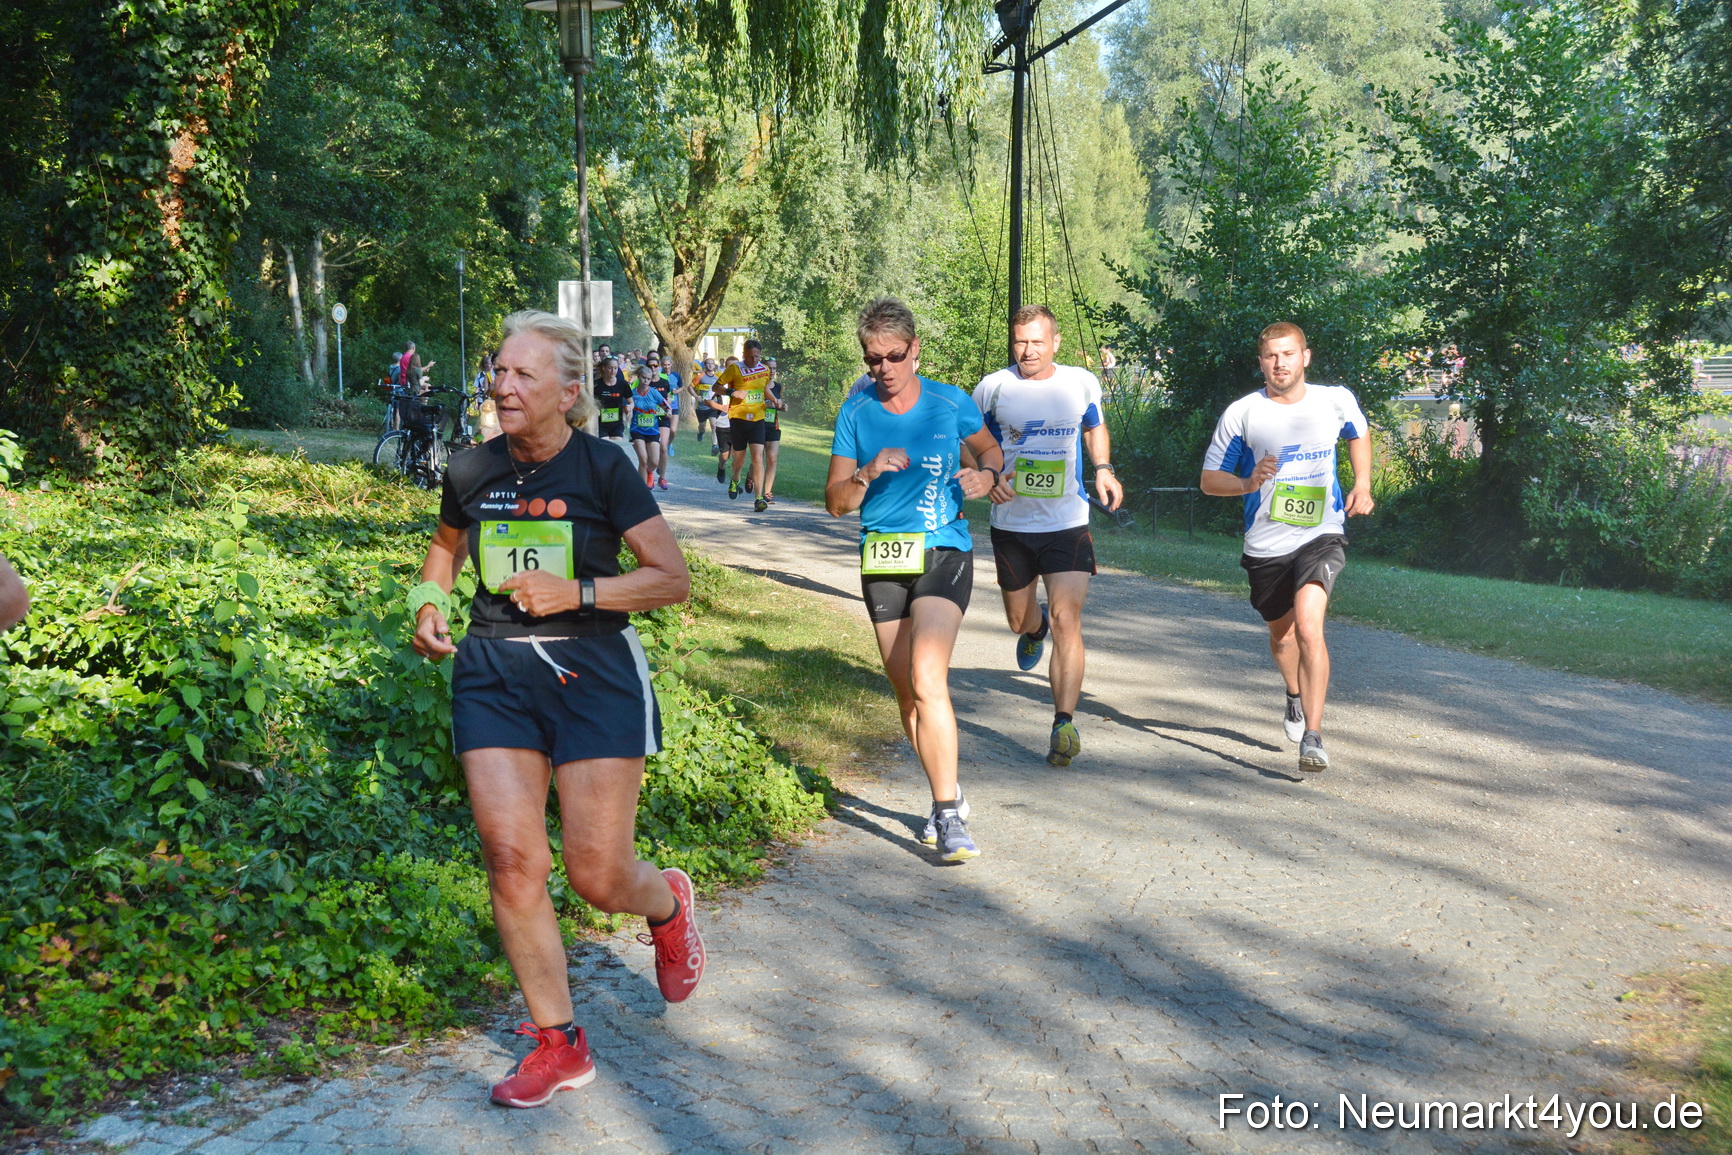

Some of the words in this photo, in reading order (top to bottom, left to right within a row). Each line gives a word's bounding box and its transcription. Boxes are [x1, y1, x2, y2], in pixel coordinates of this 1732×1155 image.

[1025, 473, 1055, 488] 629
[490, 491, 517, 499] APTIV
[480, 502, 504, 511] Running
[1284, 498, 1316, 515] 630
[870, 541, 915, 559] 1397
[507, 548, 540, 573] 16
